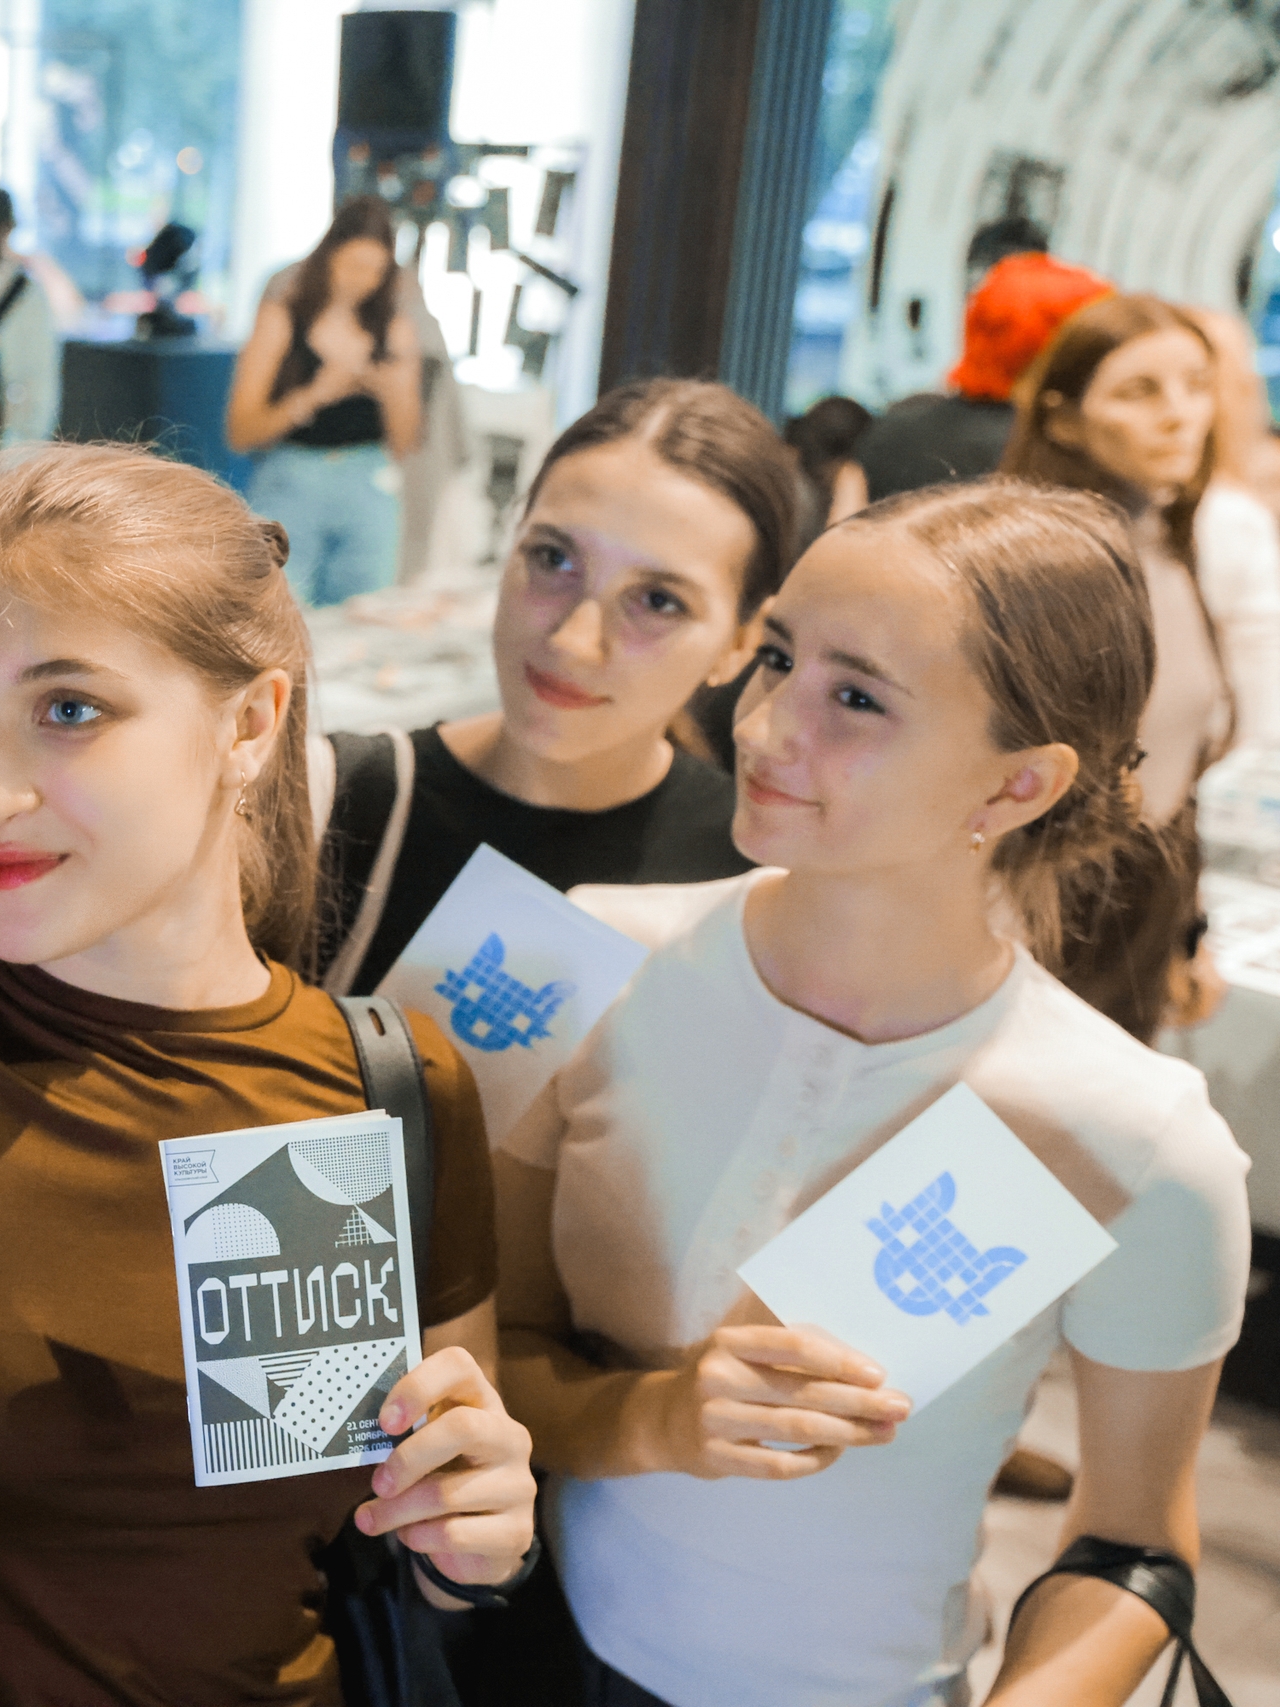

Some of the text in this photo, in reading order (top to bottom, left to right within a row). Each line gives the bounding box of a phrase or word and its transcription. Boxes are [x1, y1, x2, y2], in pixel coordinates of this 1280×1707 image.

[173, 1156, 191, 1164] КРАЙ
[173, 1161, 206, 1170] ВЫСОКОЙ
[174, 1168, 207, 1176] КУЛЬТУРЫ
[197, 1257, 398, 1345] ОТТИСК
[346, 1419, 380, 1431] 21 СЕНТ
[347, 1433, 354, 1443] 1
